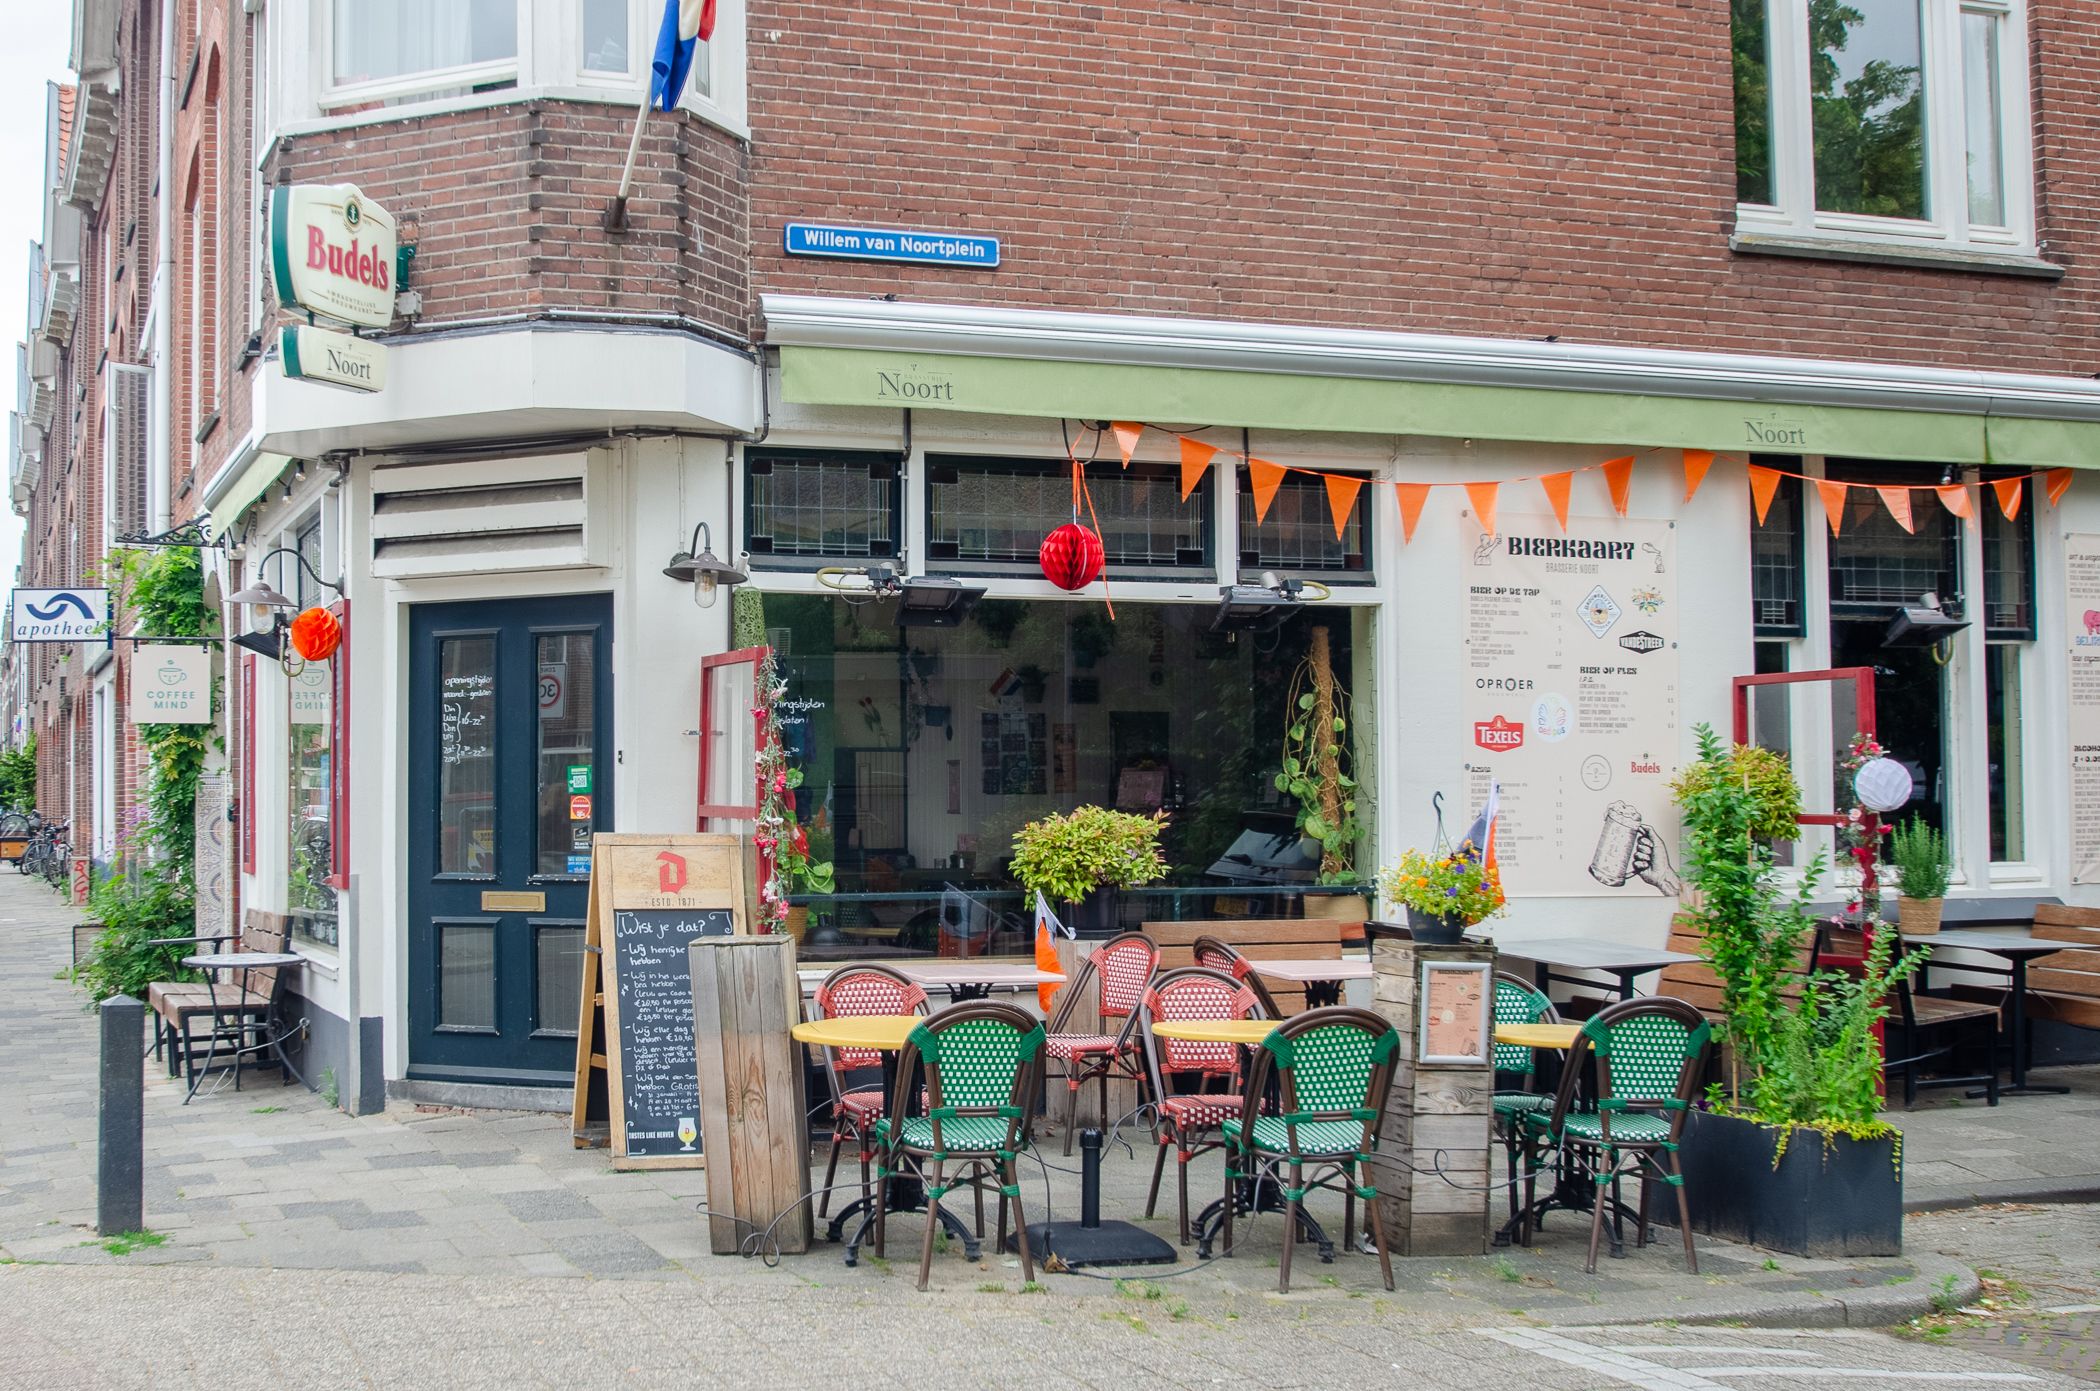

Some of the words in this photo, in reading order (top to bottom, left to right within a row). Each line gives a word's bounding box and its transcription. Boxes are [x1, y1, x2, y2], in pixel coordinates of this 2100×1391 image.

[804, 229, 860, 250] Willem
[866, 237, 895, 252] van
[900, 236, 985, 258] Noortplein
[306, 223, 389, 292] Budels
[328, 349, 370, 380] Noort
[877, 372, 954, 400] Noort
[1744, 421, 1806, 444] Noort
[1546, 563, 1578, 574] BRASSERIE
[1580, 564, 1600, 574] NOORT
[1470, 586, 1492, 594] BIER
[1494, 586, 1507, 595] OP
[1510, 588, 1520, 596] DE
[1580, 666, 1600, 674] BIER
[1602, 666, 1614, 674] OP
[1618, 667, 1637, 675] FLES
[1476, 678, 1533, 692] OPROER
[146, 690, 196, 700] COFFEE
[154, 700, 188, 710] MIND
[1478, 726, 1520, 744] TEXELS
[1631, 762, 1660, 774] Budels
[656, 851, 688, 894] D
[621, 916, 654, 934] Wist
[656, 919, 670, 939] je
[676, 920, 706, 935] dat?
[630, 957, 662, 966] hebben
[674, 1026, 688, 1036] dag
